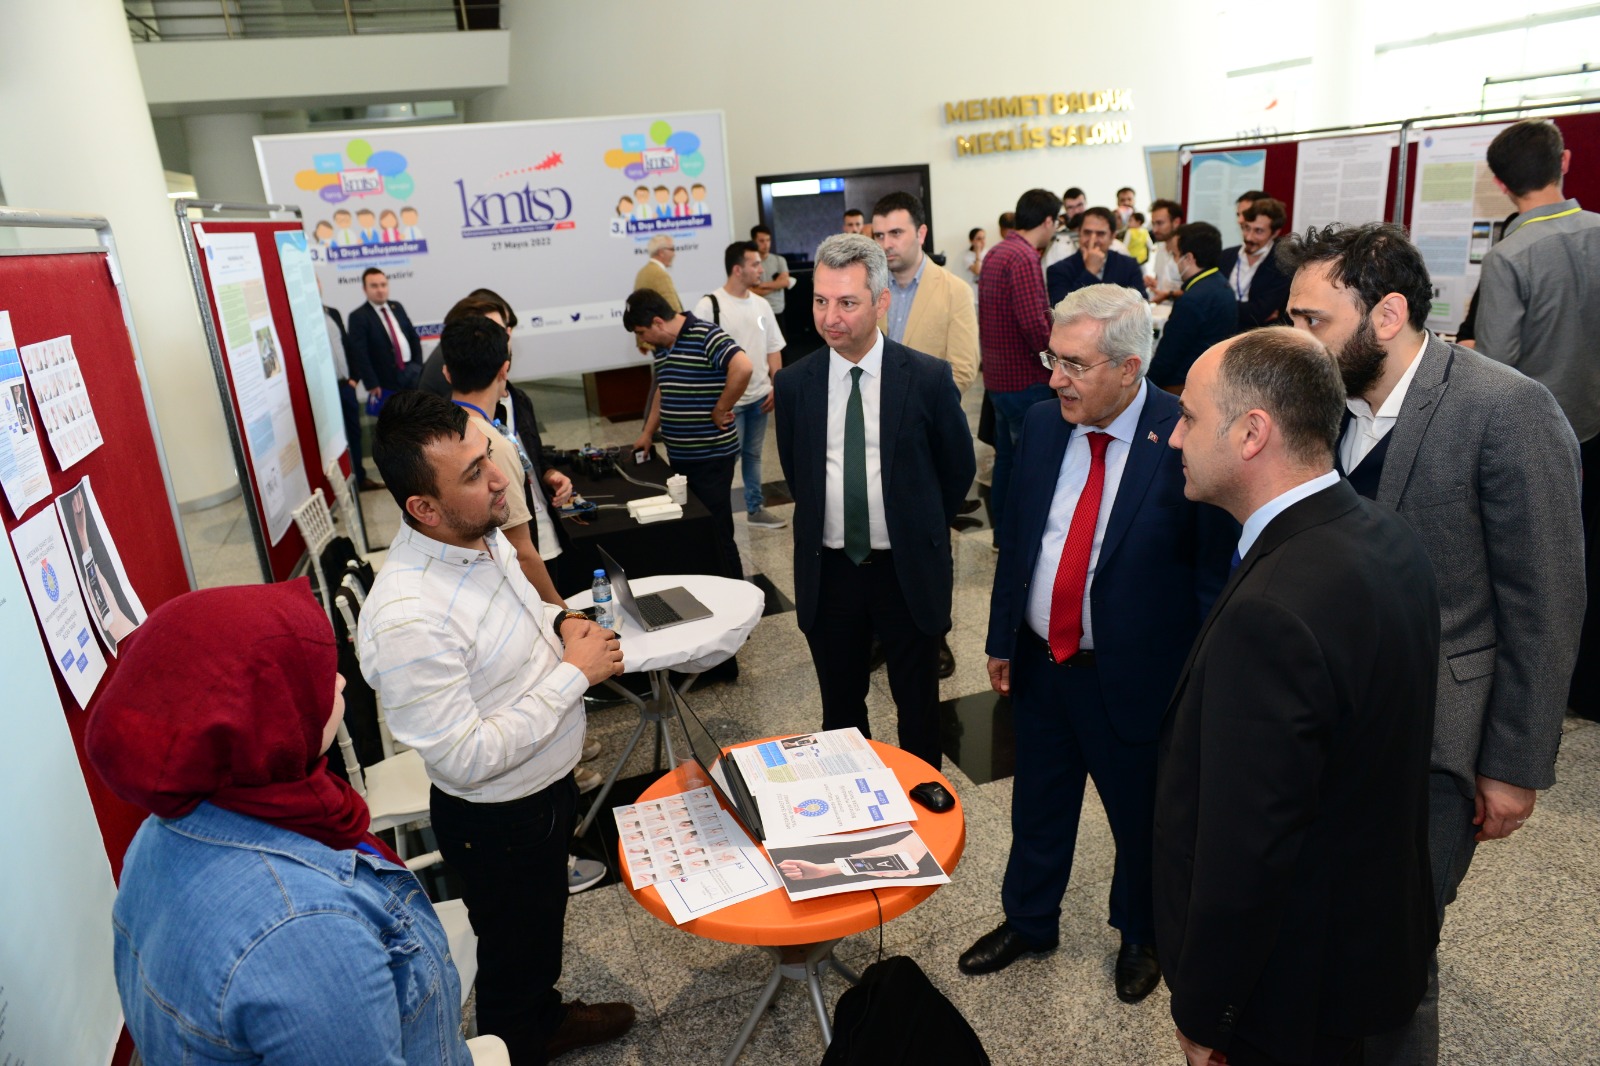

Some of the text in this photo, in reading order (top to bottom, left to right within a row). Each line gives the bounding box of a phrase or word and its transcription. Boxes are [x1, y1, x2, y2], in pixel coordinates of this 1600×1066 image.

[944, 95, 1047, 124] MEHMET
[956, 123, 1045, 157] MECLİS
[611, 222, 624, 235] 3.
[361, 243, 419, 257] Buluşmalar
